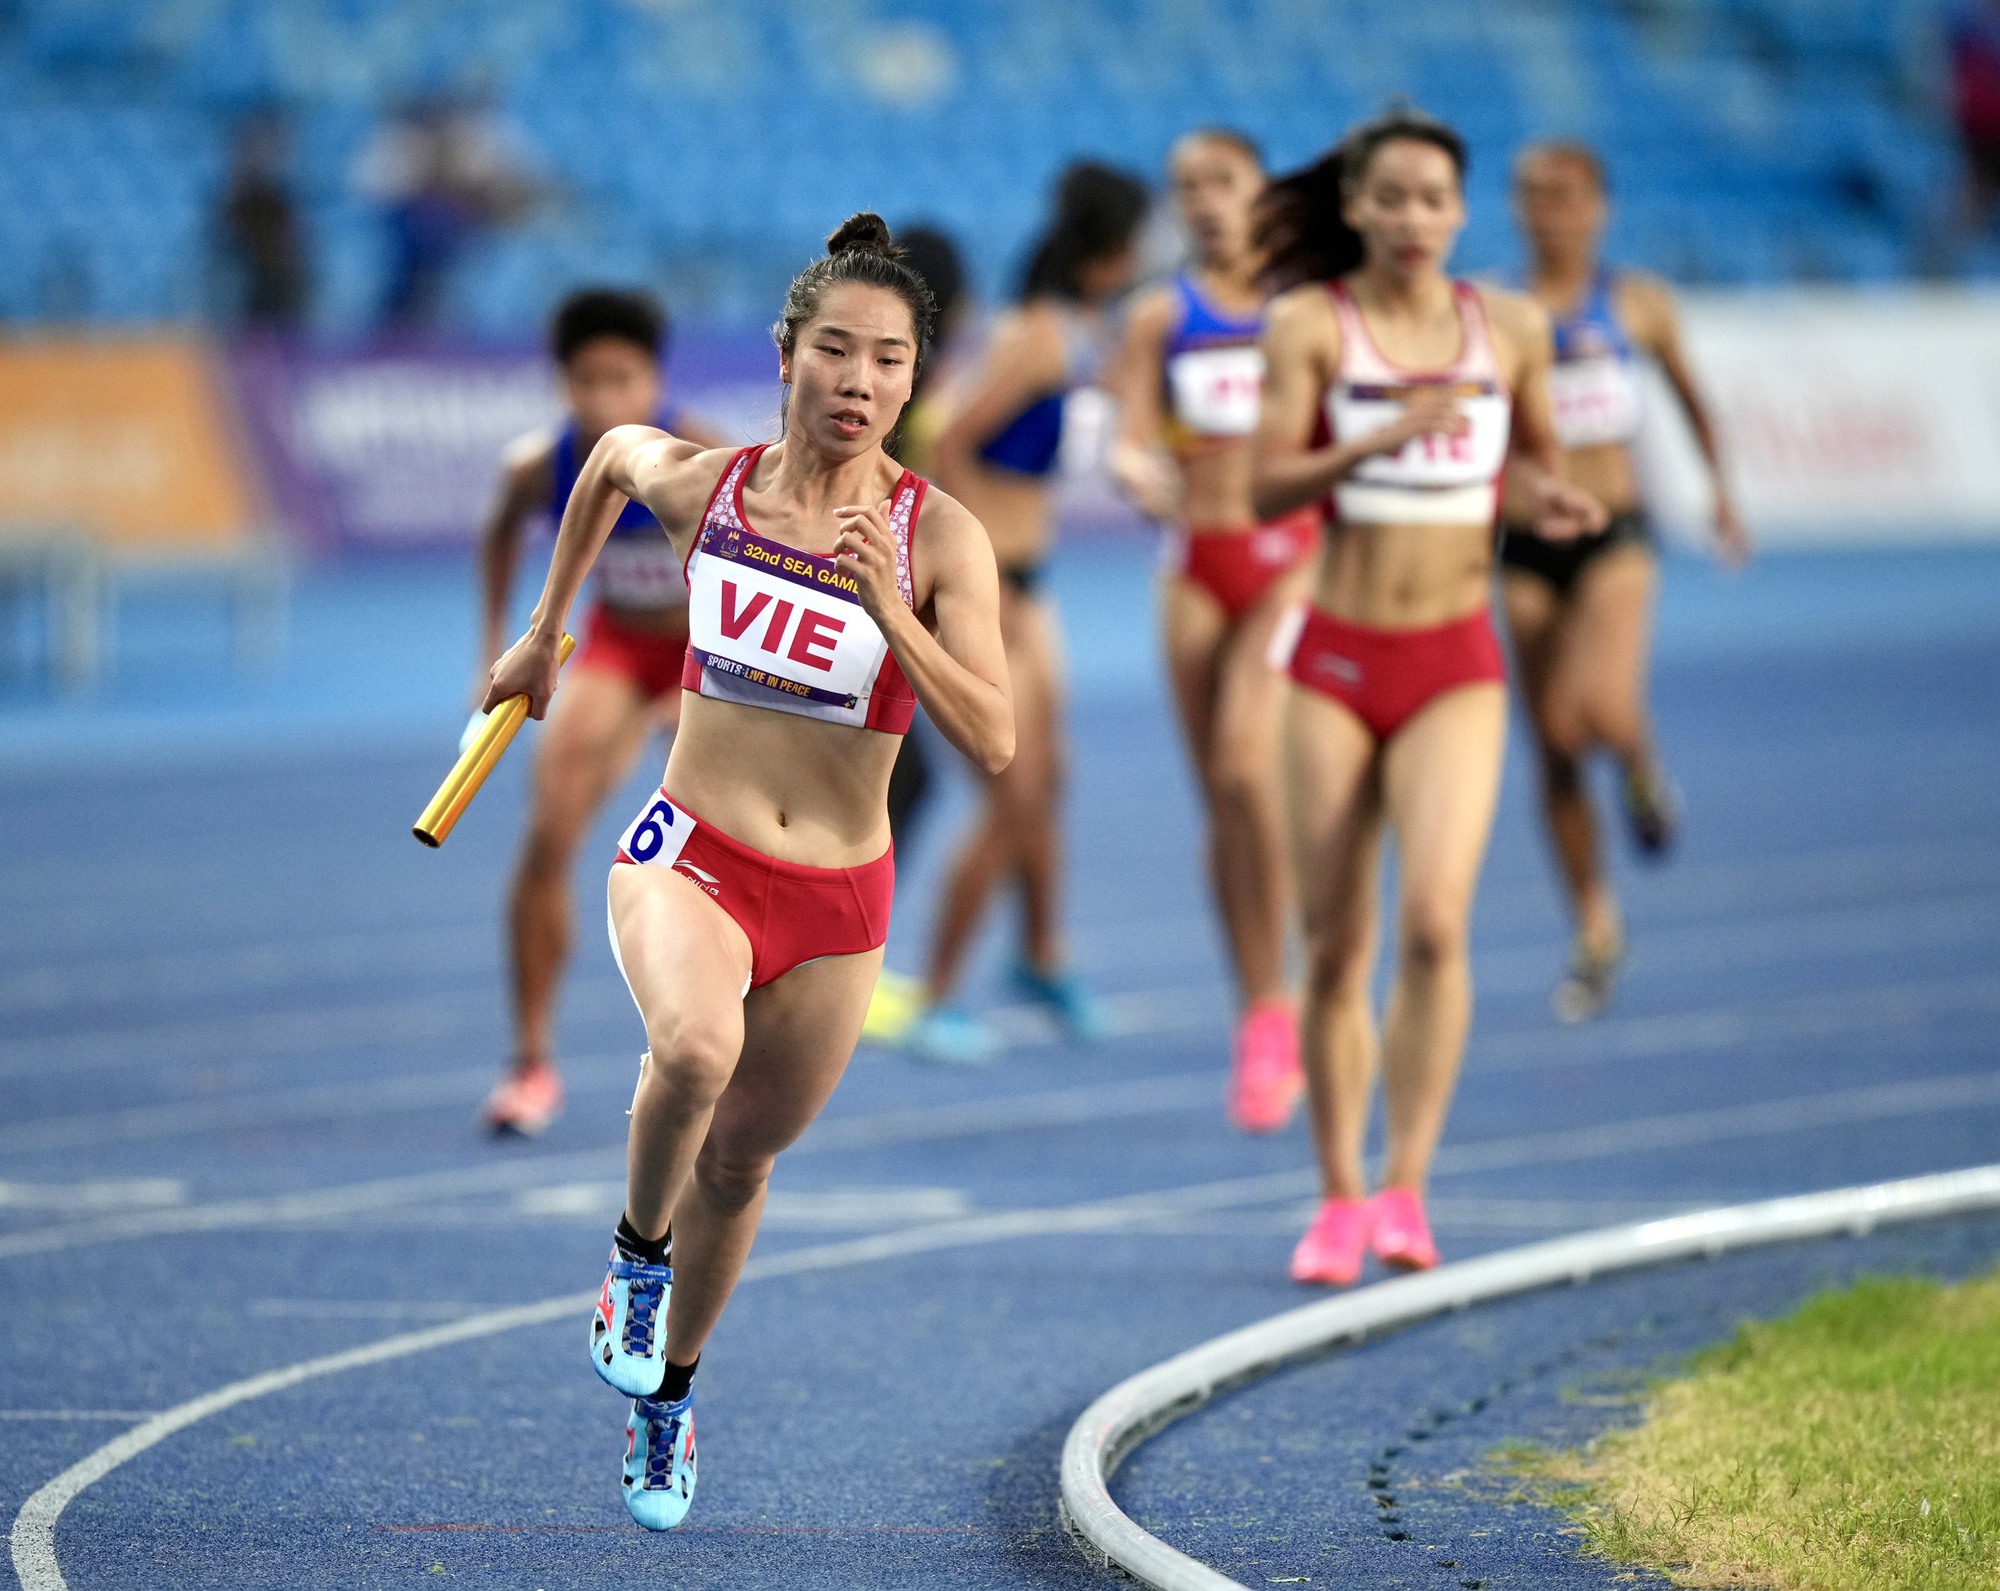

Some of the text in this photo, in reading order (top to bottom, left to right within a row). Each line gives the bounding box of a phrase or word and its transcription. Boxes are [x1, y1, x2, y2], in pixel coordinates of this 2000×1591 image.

[743, 543, 781, 566] 32nd
[782, 557, 813, 578] SEA
[720, 579, 847, 673] VIE
[766, 675, 779, 688] IN
[779, 678, 811, 698] PEACE
[629, 800, 674, 863] 6
